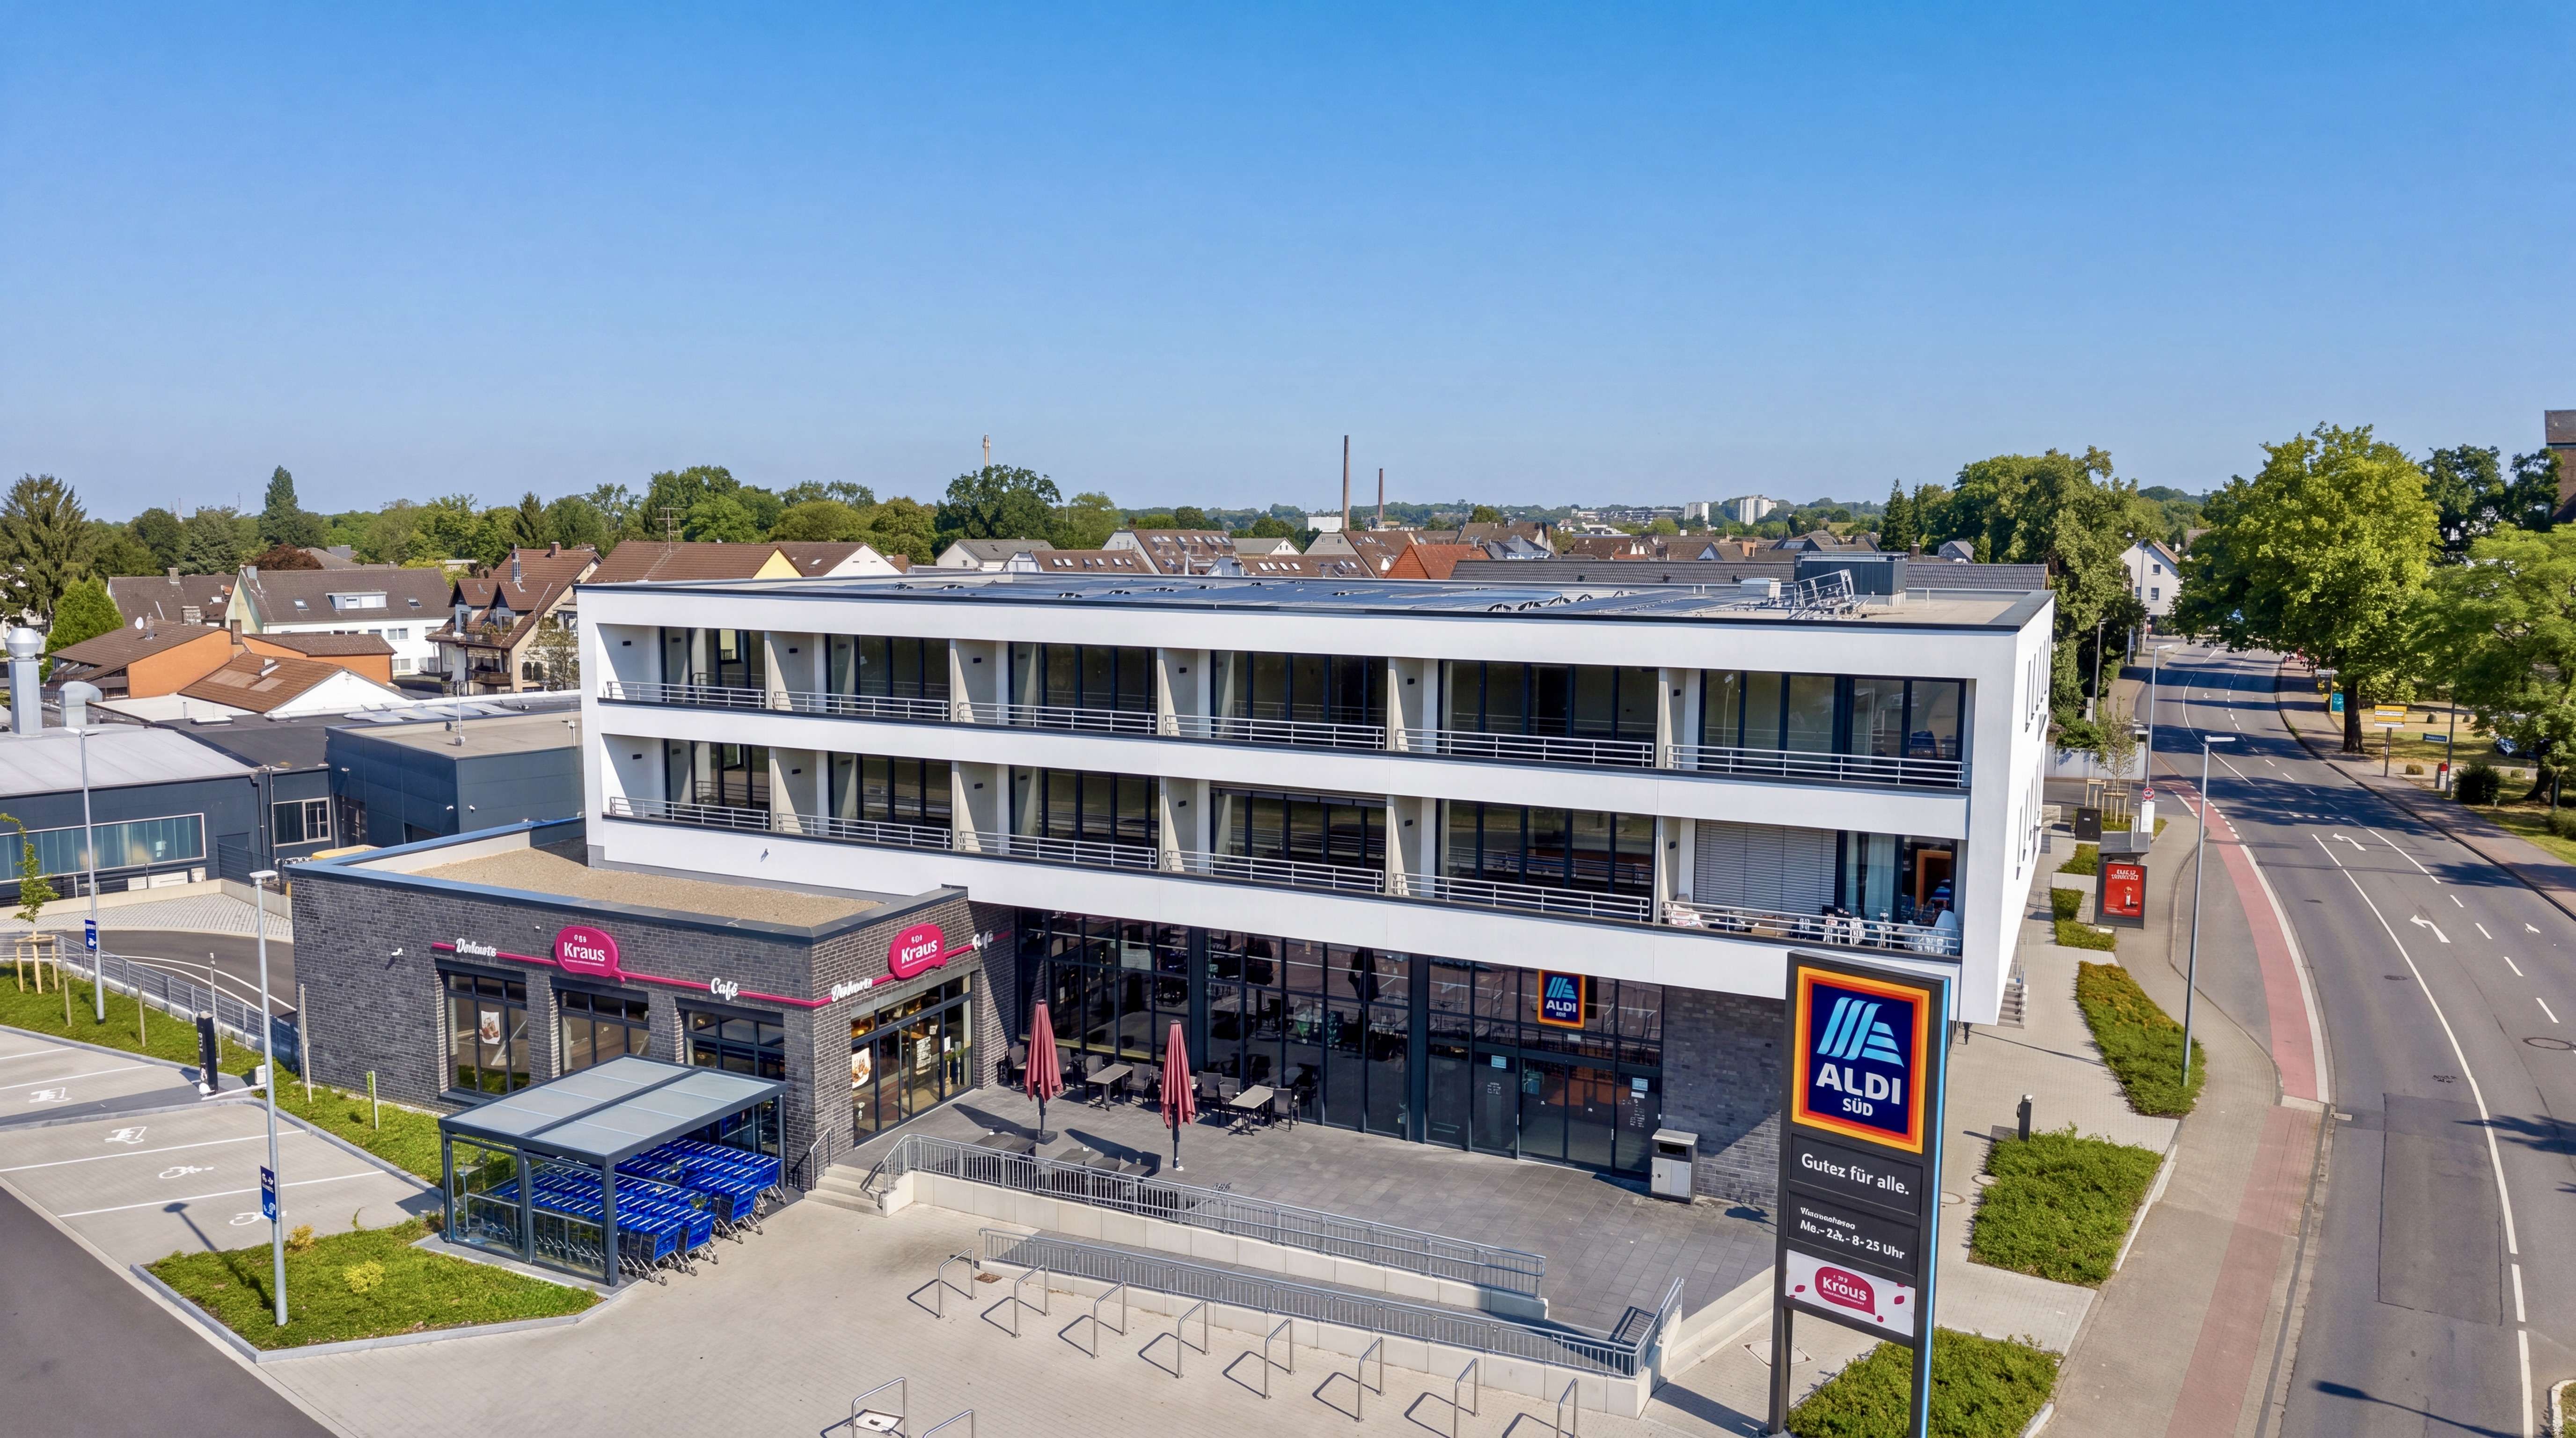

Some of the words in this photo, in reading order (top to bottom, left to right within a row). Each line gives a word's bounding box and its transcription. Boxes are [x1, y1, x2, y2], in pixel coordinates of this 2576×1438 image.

[564, 942, 605, 961] Kraus
[901, 940, 937, 964] Kraus
[1546, 999, 1576, 1012] ALDI
[1816, 1063, 1901, 1105] ALDI
[1842, 1098, 1873, 1116] SÜD
[1801, 1153, 1845, 1178] Gutez
[1850, 1166, 1873, 1185] für
[1877, 1175, 1910, 1195] alle.
[1883, 1244, 1905, 1259] Uhr
